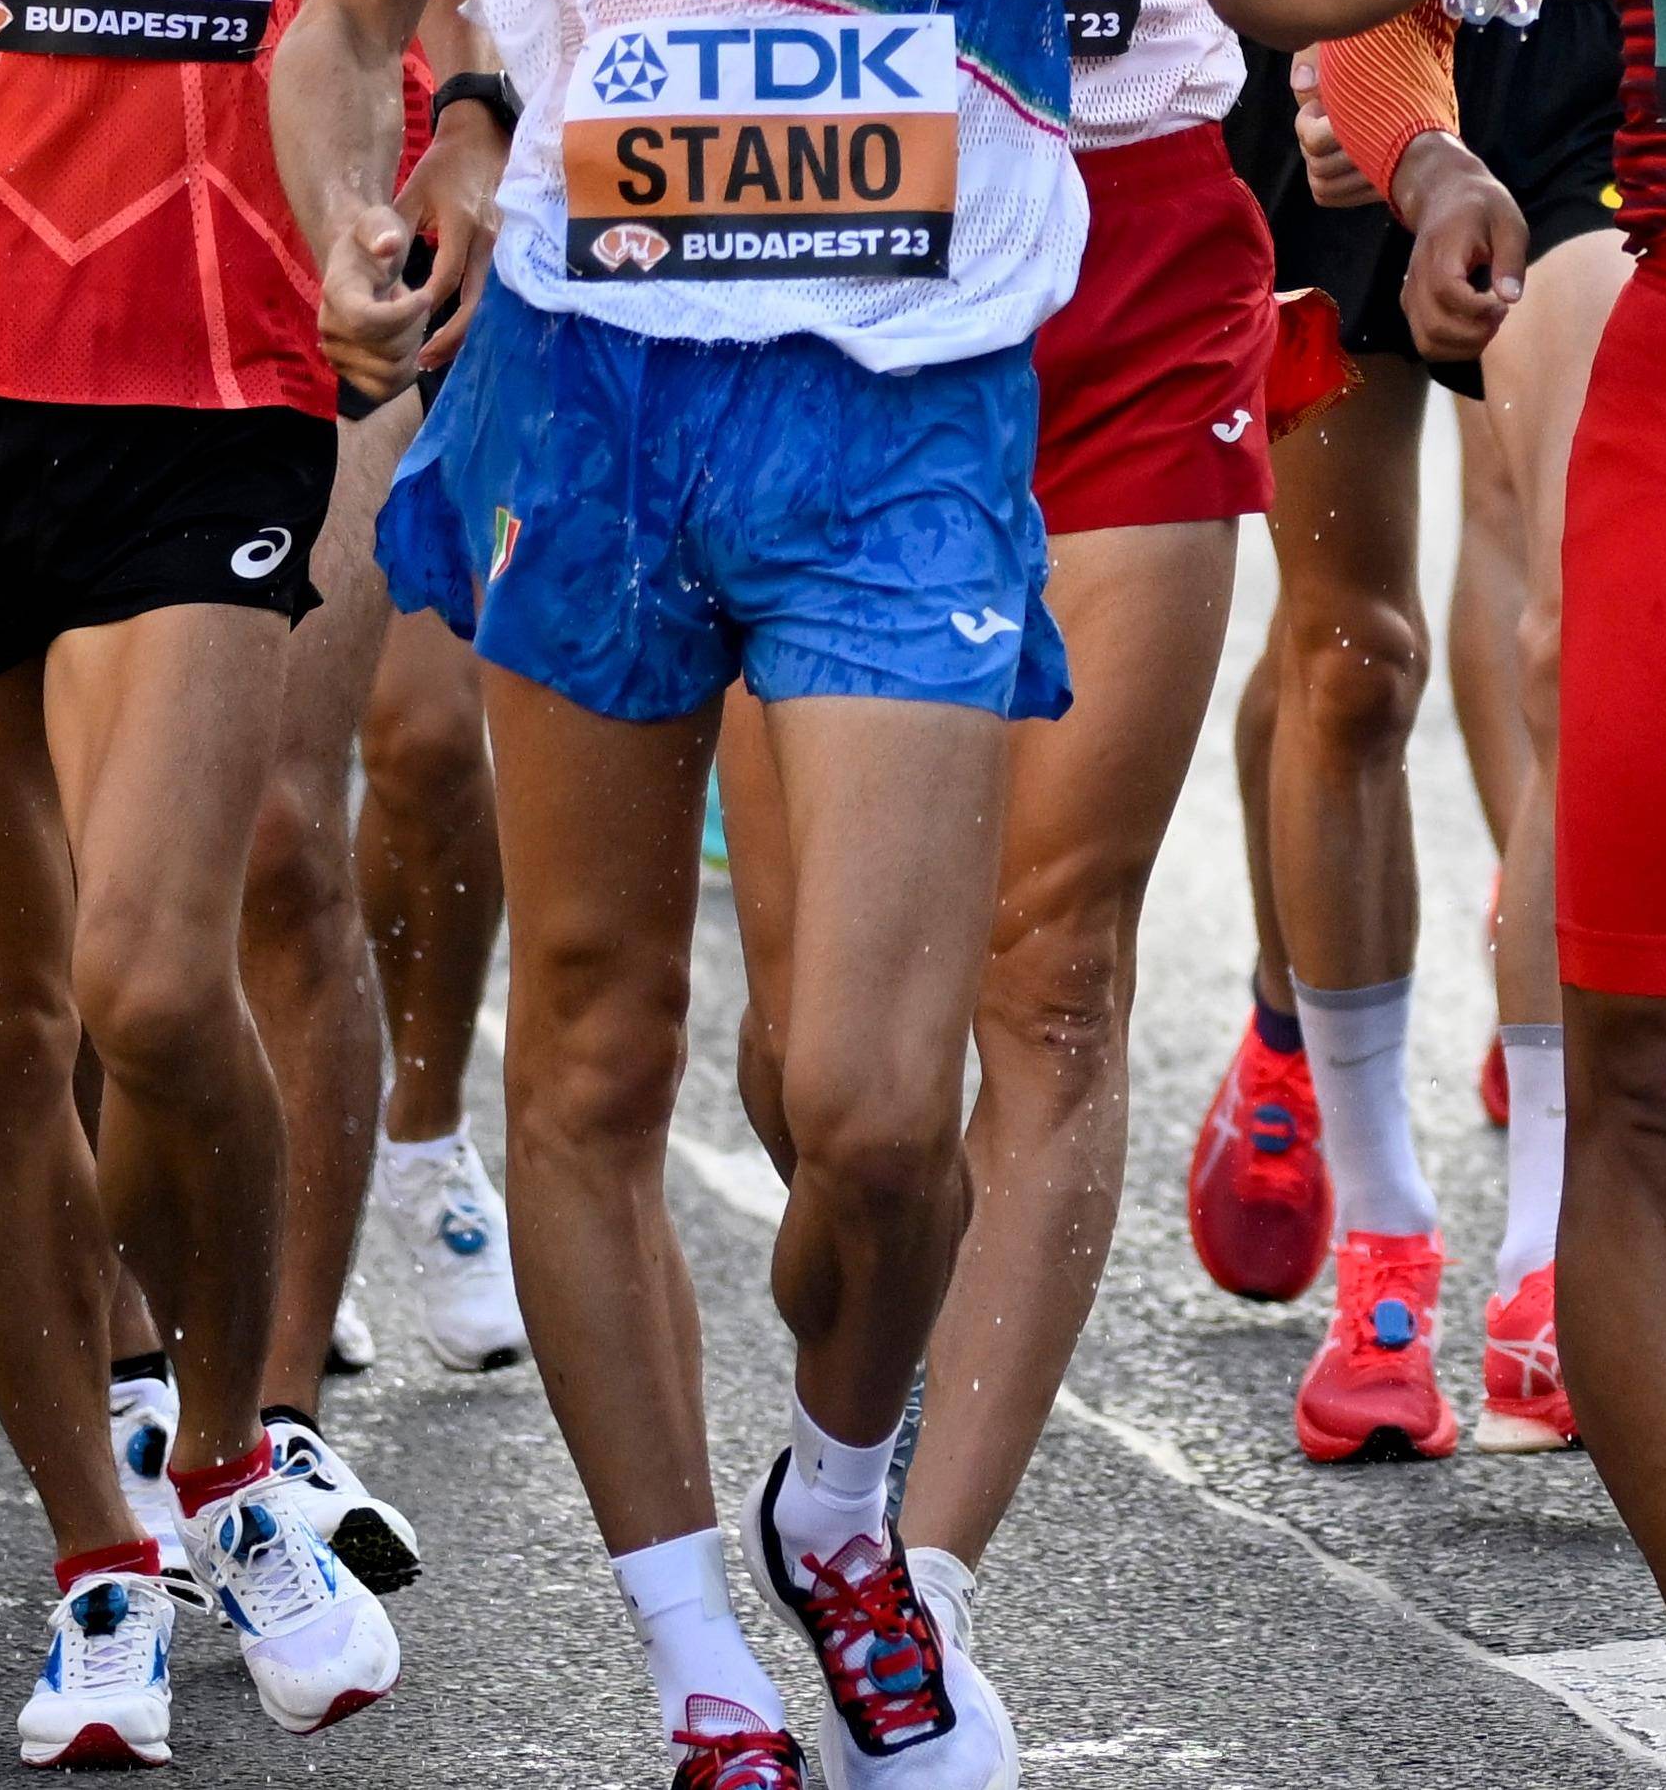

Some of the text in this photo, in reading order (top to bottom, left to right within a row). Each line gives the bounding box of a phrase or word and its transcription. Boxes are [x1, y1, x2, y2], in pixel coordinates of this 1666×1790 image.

[24, 4, 249, 42] BUDAPEST 23
[1081, 12, 1121, 38] 23
[667, 27, 923, 101] TDK
[616, 121, 903, 206] STANO
[682, 226, 931, 262] BUDAPEST 23
